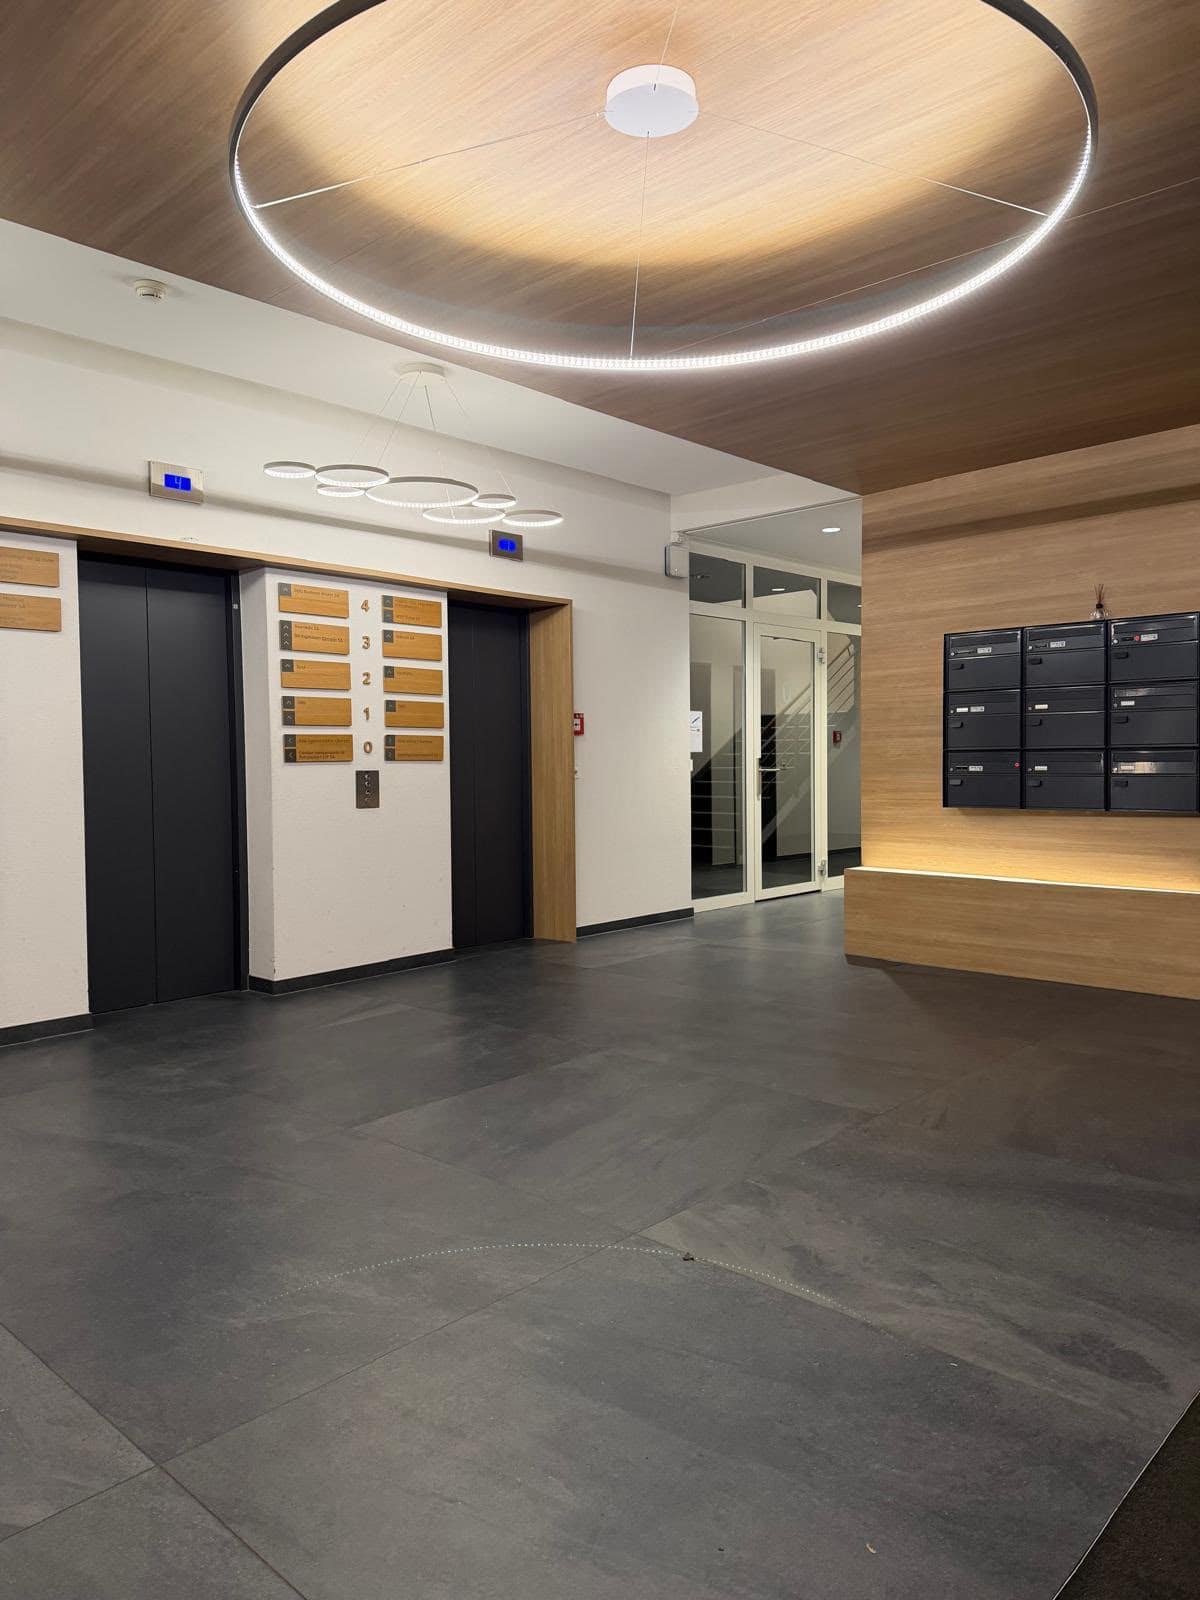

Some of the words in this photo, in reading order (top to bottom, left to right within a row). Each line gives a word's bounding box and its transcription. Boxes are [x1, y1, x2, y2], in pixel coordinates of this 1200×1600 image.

[361, 600, 370, 612] 4
[361, 636, 371, 650] 3
[362, 672, 371, 686] 2
[363, 707, 370, 721] 1
[363, 741, 373, 754] 0
